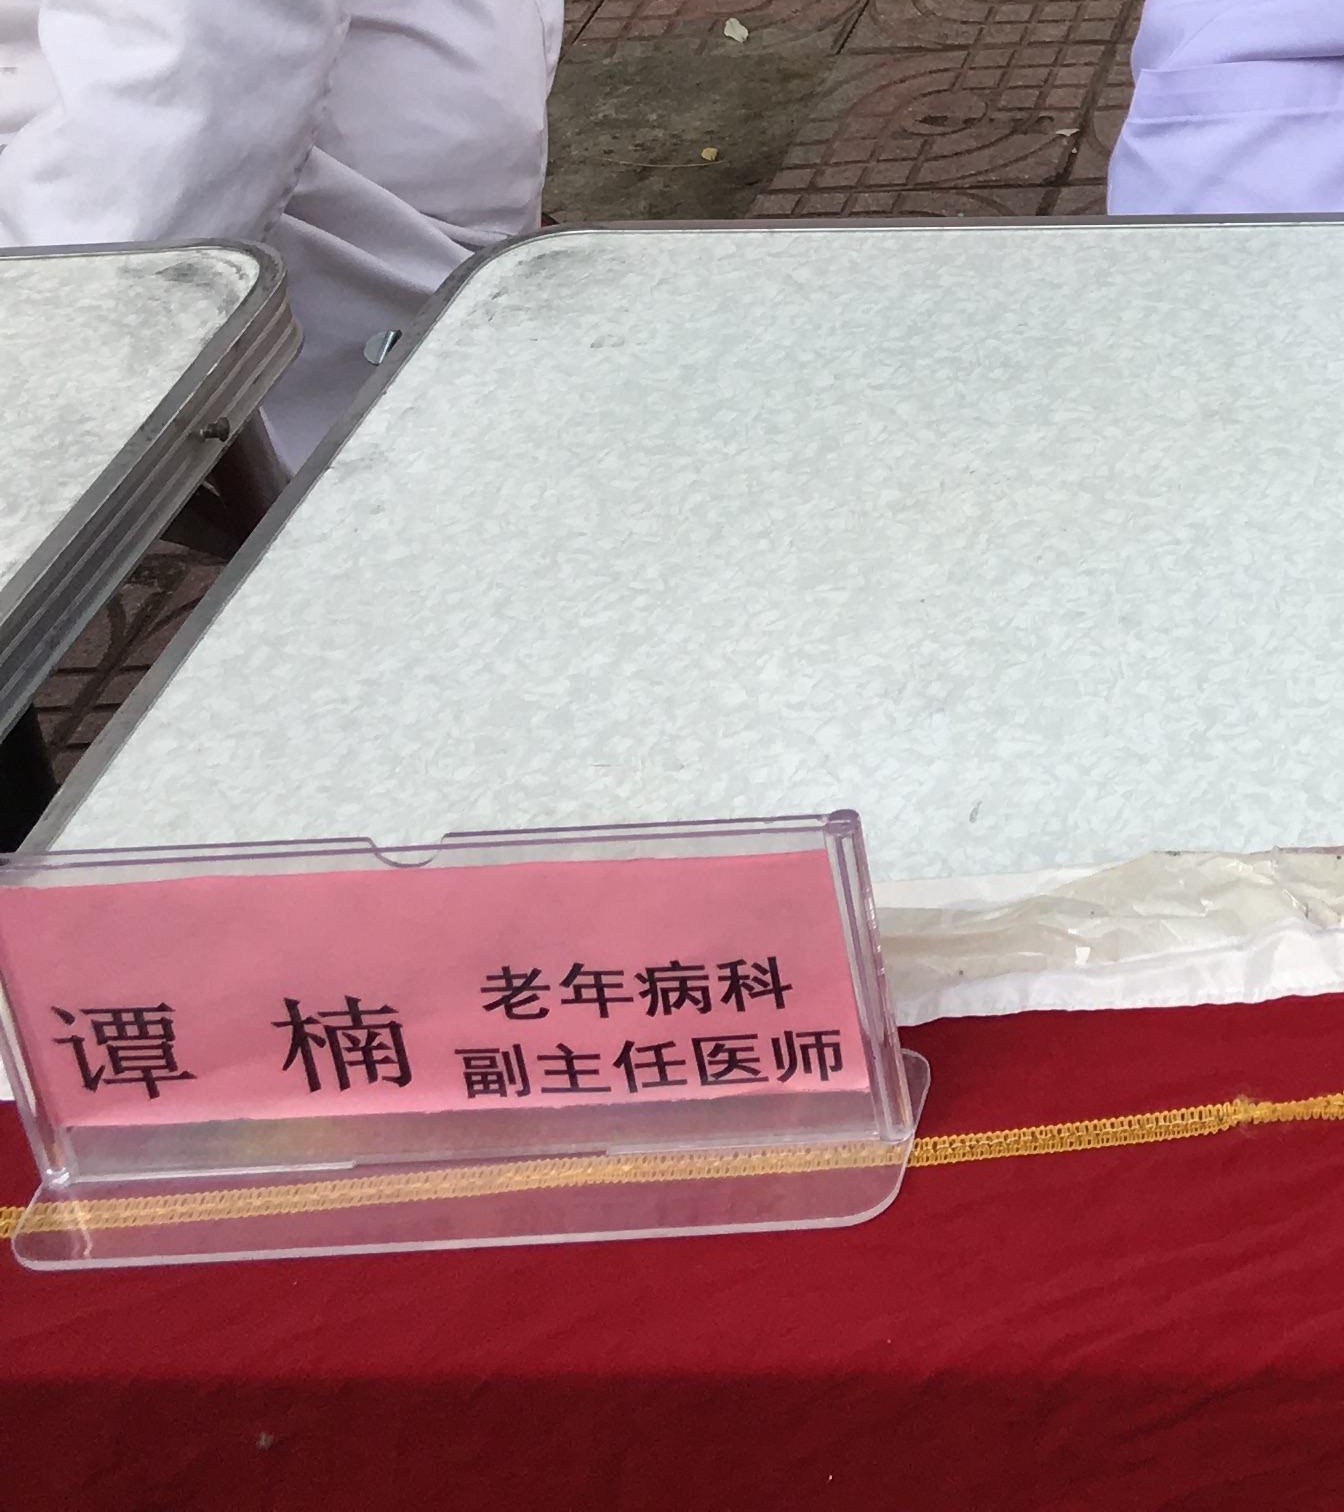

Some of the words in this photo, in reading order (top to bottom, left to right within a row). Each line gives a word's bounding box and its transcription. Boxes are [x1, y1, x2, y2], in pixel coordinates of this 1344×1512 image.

[479, 955, 794, 1021] 老年病科
[453, 1028, 845, 1100] 副主任医师
